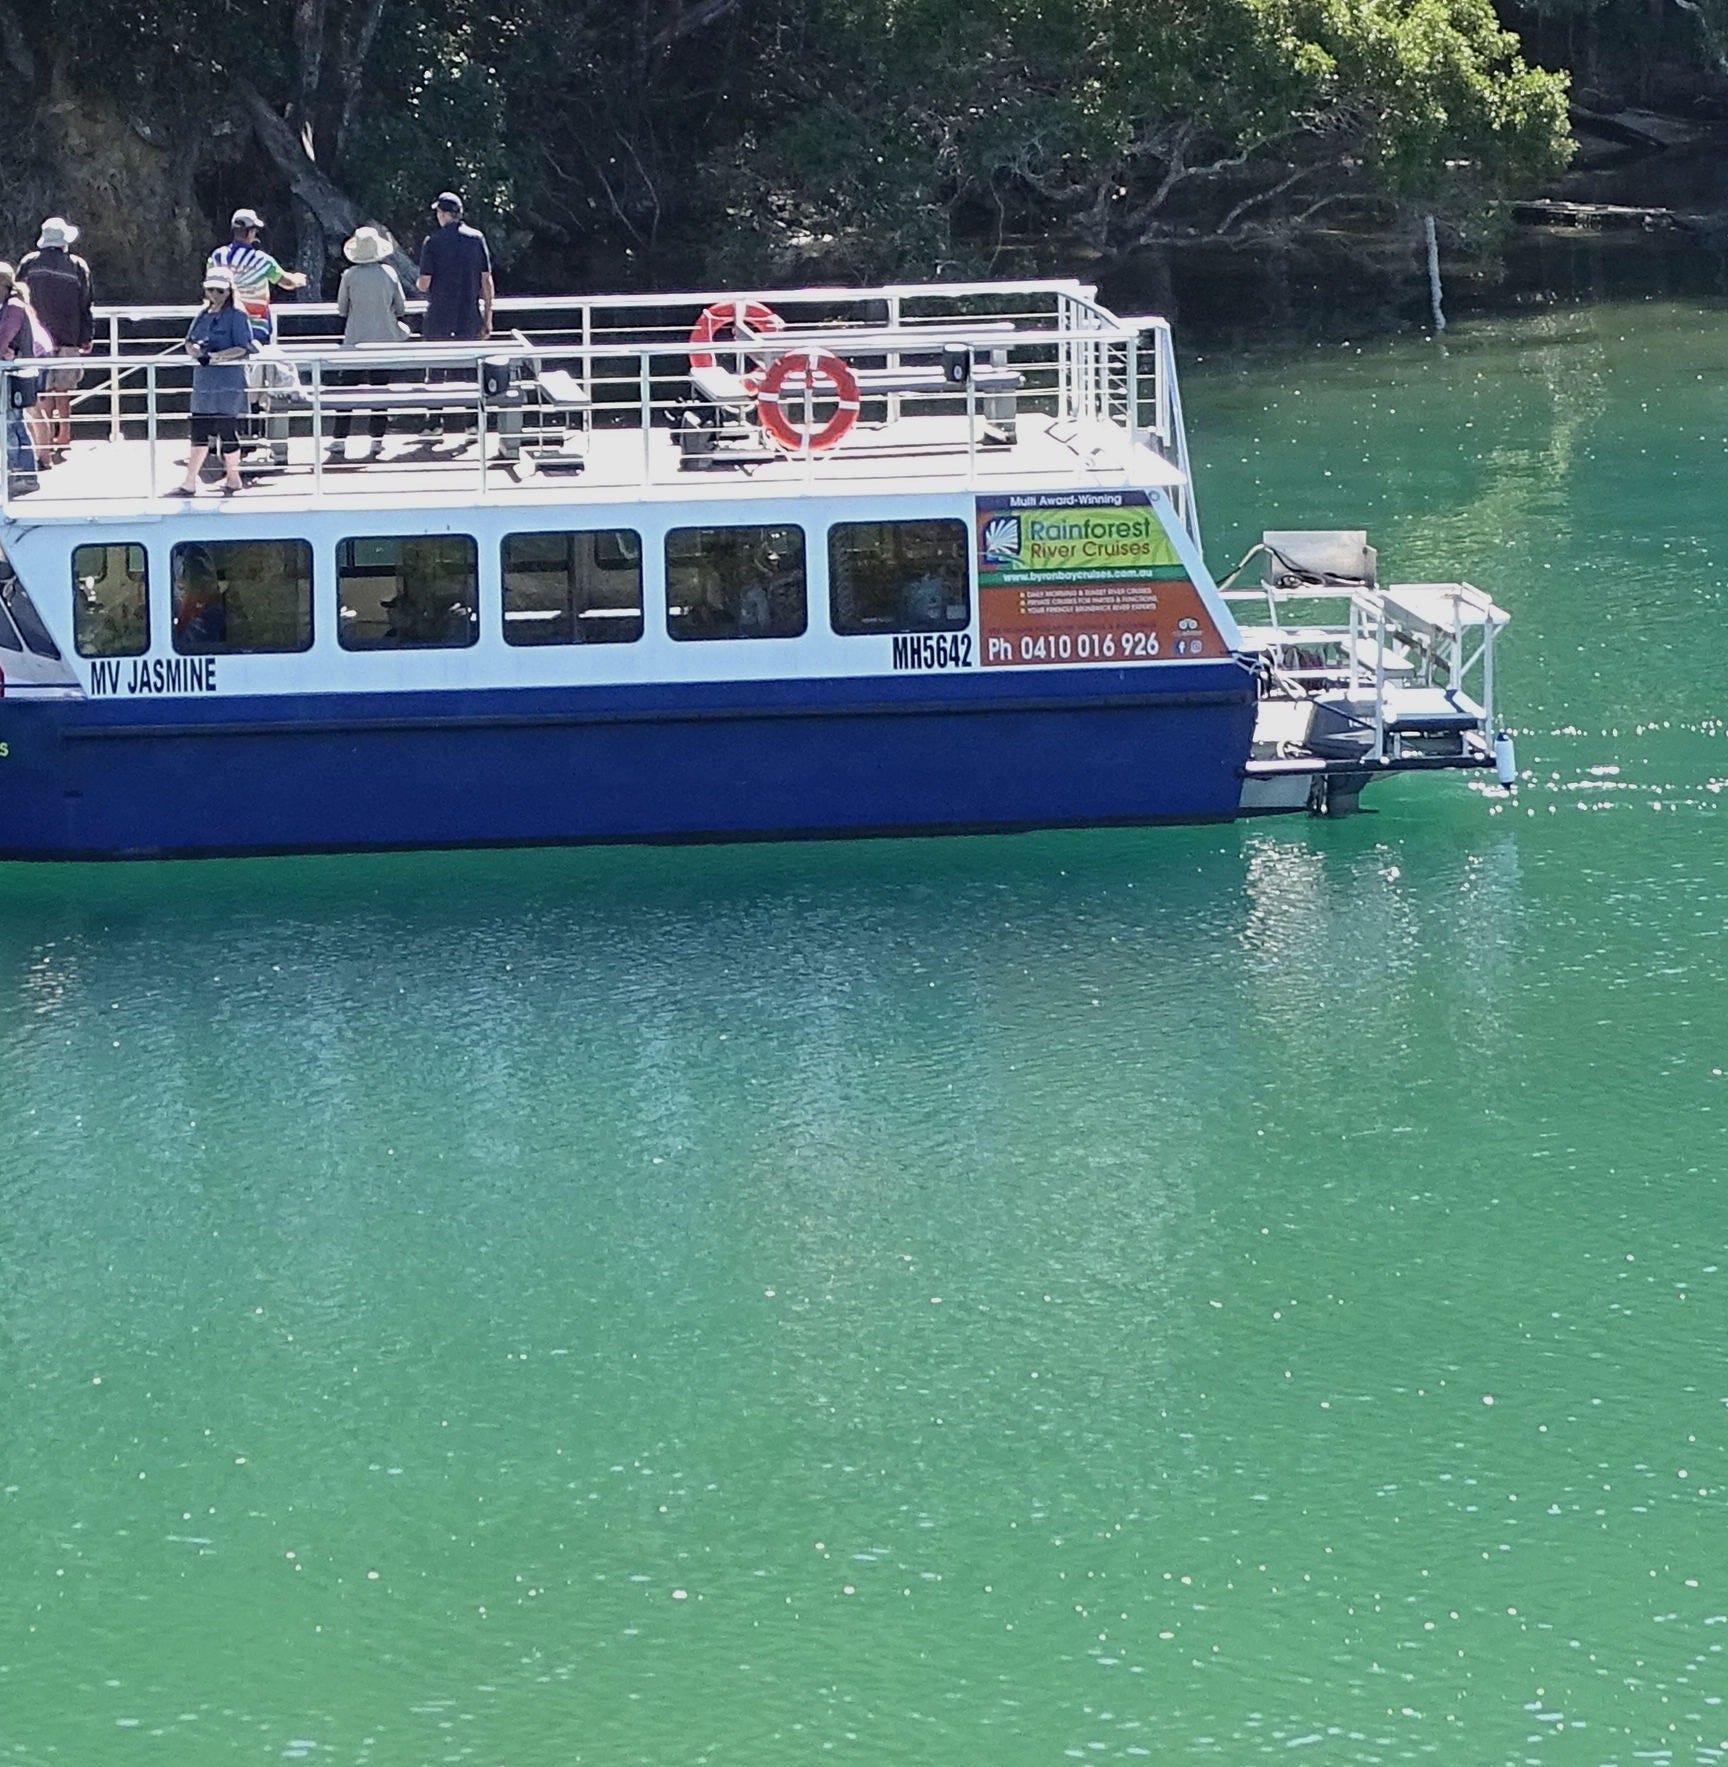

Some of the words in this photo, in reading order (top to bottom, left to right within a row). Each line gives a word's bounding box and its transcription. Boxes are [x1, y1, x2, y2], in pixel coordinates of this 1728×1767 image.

[1010, 496, 1037, 507] Multi
[1039, 493, 1122, 506] Award-Winning
[1030, 517, 1151, 541] Rainforest
[1030, 543, 1076, 559] River
[1083, 541, 1151, 557] Cruises
[1003, 569, 1153, 583] www.byronbaycruises.com.au
[892, 634, 973, 670] MH5642
[987, 637, 1012, 661] Ph
[1020, 635, 1071, 660] 0410
[1077, 633, 1116, 658] 016
[1121, 631, 1160, 656] 926
[91, 660, 121, 695] MV
[127, 657, 217, 694] JASMINE
